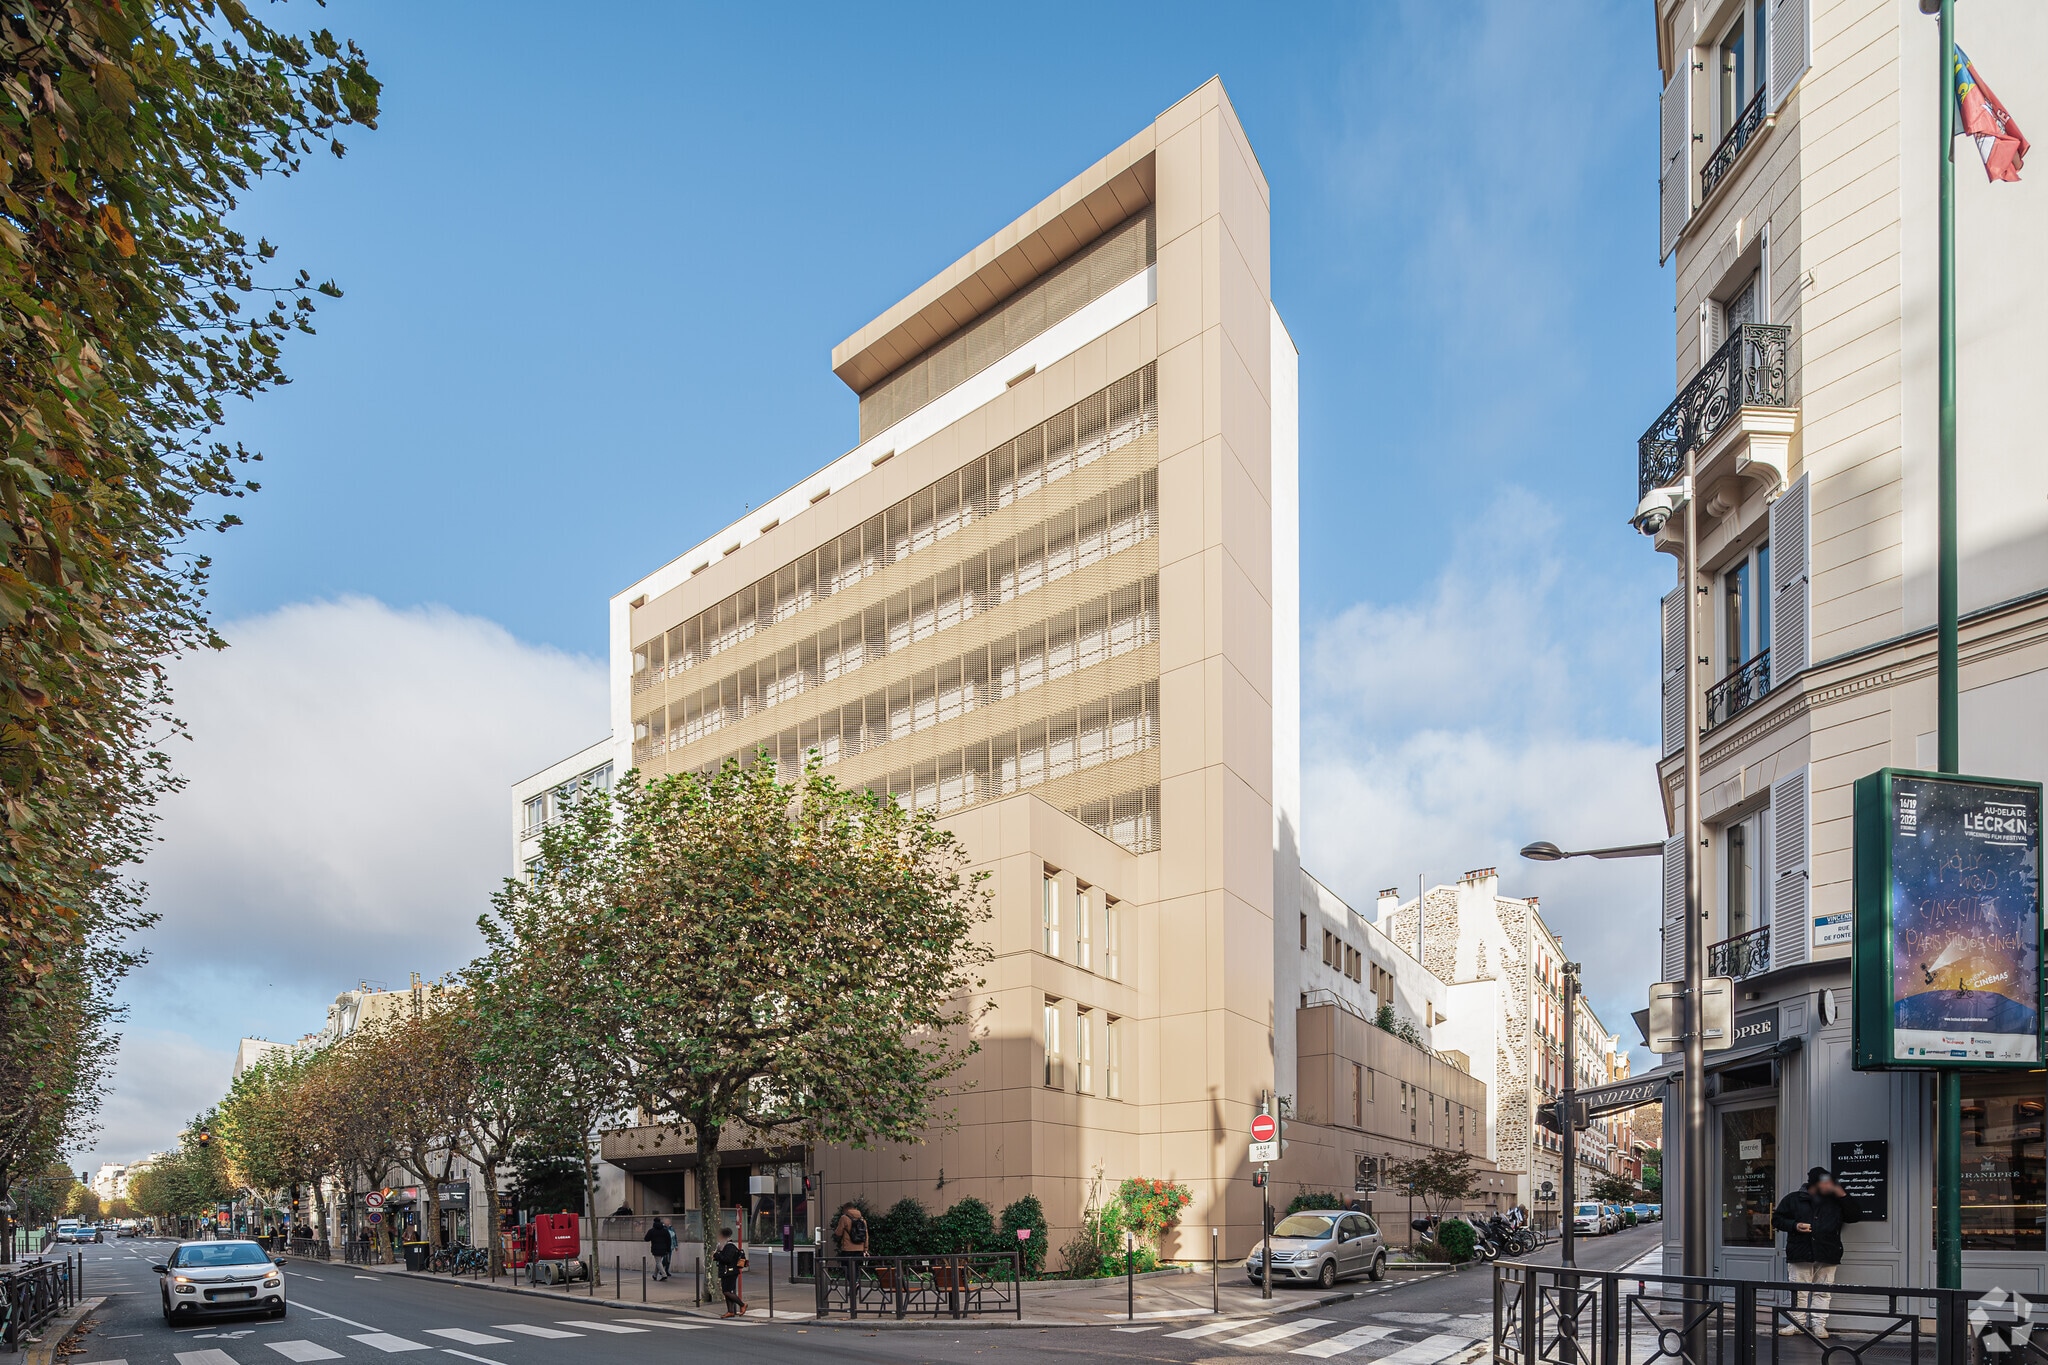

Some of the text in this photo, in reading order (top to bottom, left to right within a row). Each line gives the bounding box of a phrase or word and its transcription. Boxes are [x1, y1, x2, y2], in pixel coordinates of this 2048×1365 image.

[1900, 798, 1917, 809] 16/19
[1984, 806, 2026, 817] AU-DELÀ DE
[1900, 814, 1917, 825] 2023
[1964, 812, 2027, 834] L'ÉCRAN
[1964, 830, 1990, 839] VINCENNES
[1826, 912, 1852, 922] VINCENN
[1833, 932, 1852, 940] FONTE
[1974, 971, 2009, 988] CINÉMAS
[1734, 1019, 1771, 1040] DPRÉ
[1578, 1082, 1654, 1108] ANDPRÉ
